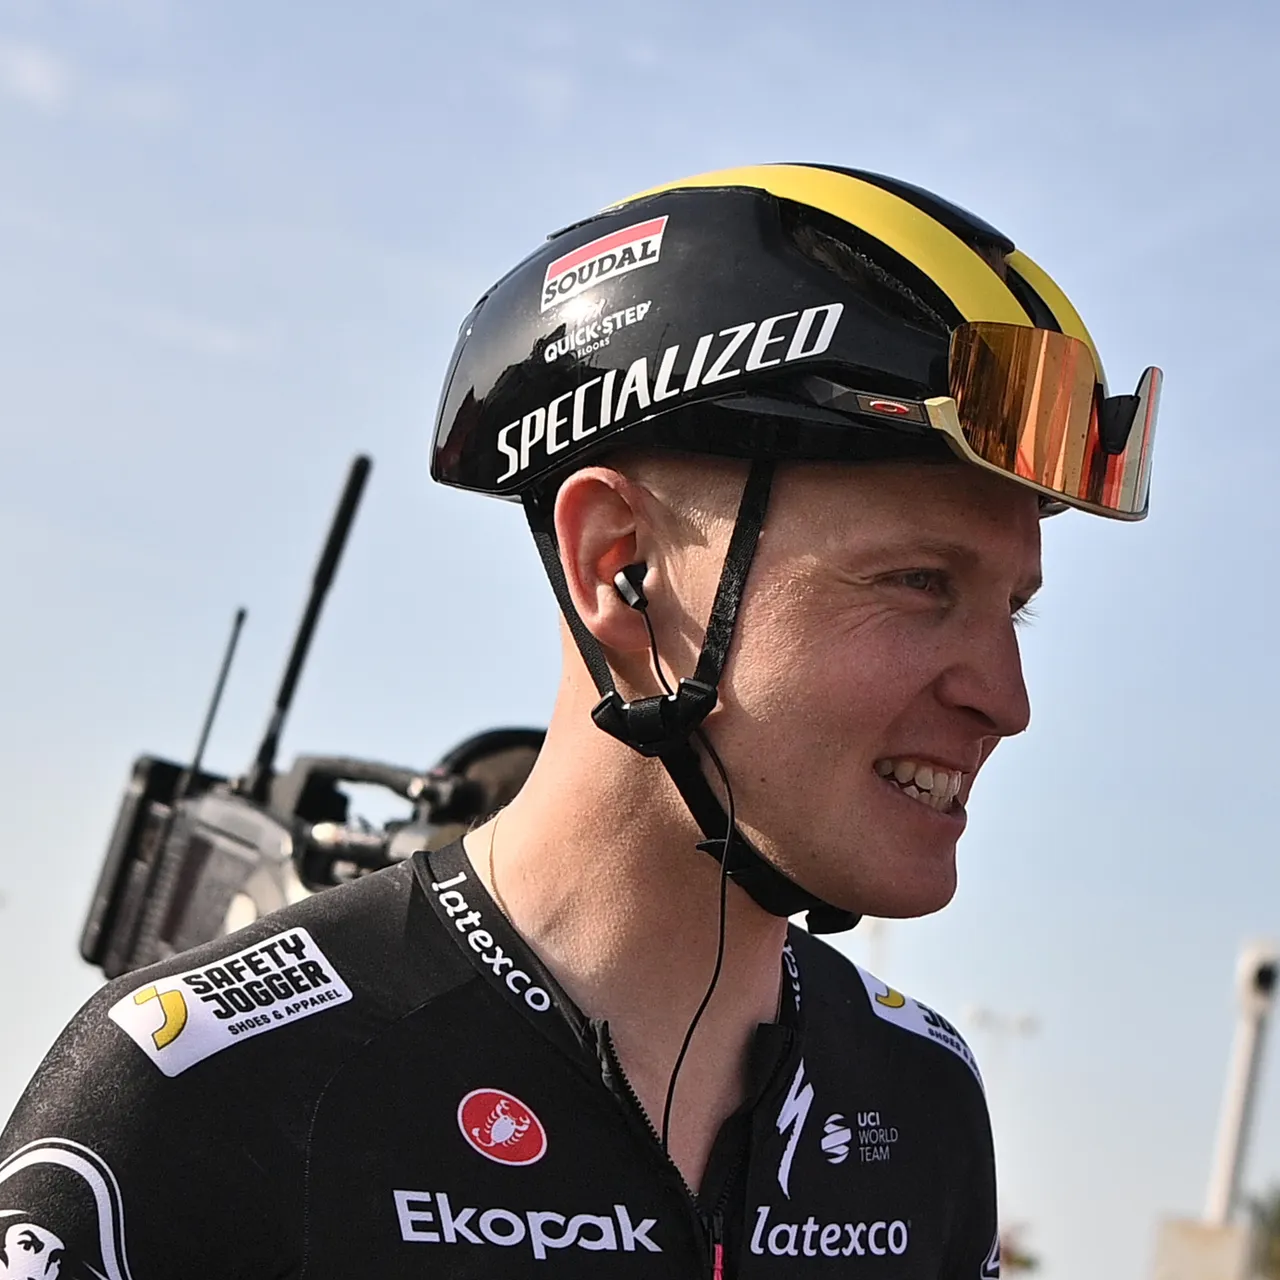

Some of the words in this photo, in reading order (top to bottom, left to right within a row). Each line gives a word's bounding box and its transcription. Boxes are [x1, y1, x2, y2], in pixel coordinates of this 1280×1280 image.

[544, 240, 657, 305] SOUDAL
[577, 337, 611, 358] FLOORS
[497, 302, 844, 484] SPECIALIZED
[182, 934, 306, 995] SAFETY
[430, 871, 551, 1013] latexco
[200, 960, 332, 1020] JOGGER
[228, 1015, 271, 1036] SHOES
[274, 1009, 284, 1020] &
[285, 988, 343, 1016] APPAREL
[858, 1112, 880, 1127] UCI
[858, 1128, 898, 1144] WORLD
[859, 1145, 890, 1162] TEAM
[392, 1188, 663, 1259] Ekopak
[749, 1205, 908, 1257] latexco
